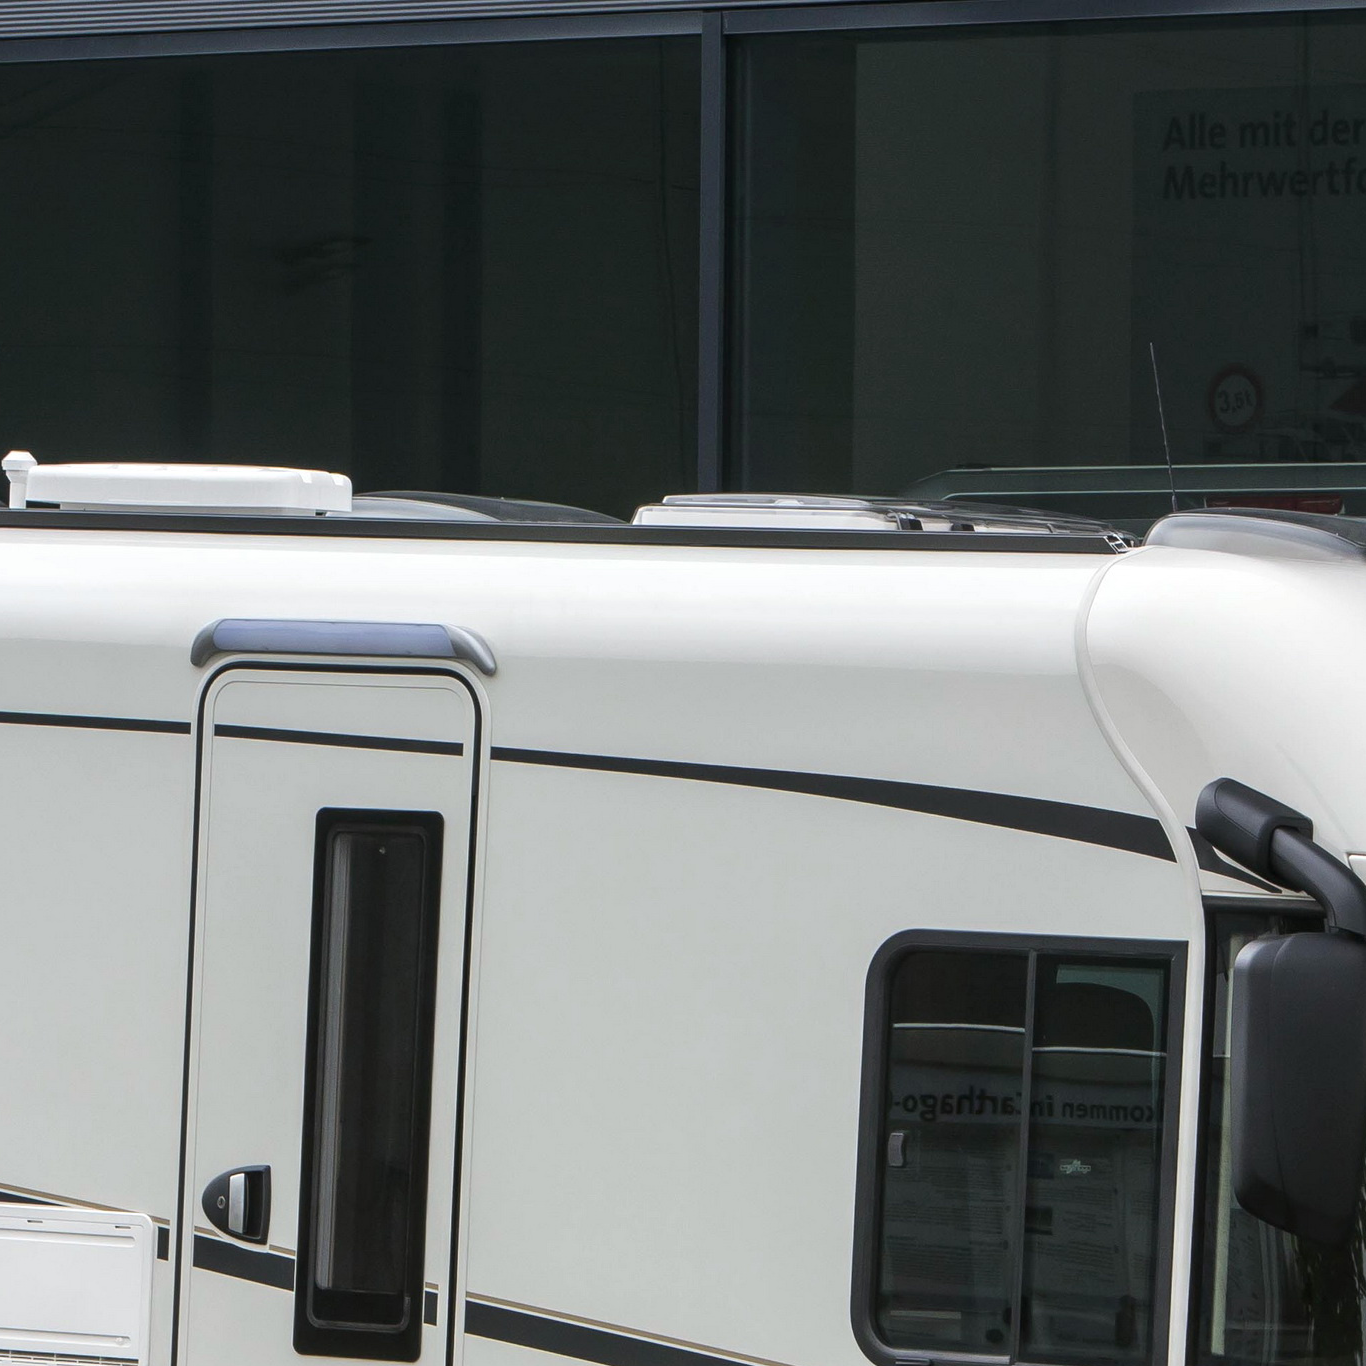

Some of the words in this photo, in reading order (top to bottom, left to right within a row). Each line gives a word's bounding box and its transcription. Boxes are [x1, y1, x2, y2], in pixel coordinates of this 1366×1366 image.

[1161, 112, 1227, 152] Alle
[1239, 109, 1295, 149] mit
[1308, 108, 1366, 147] der
